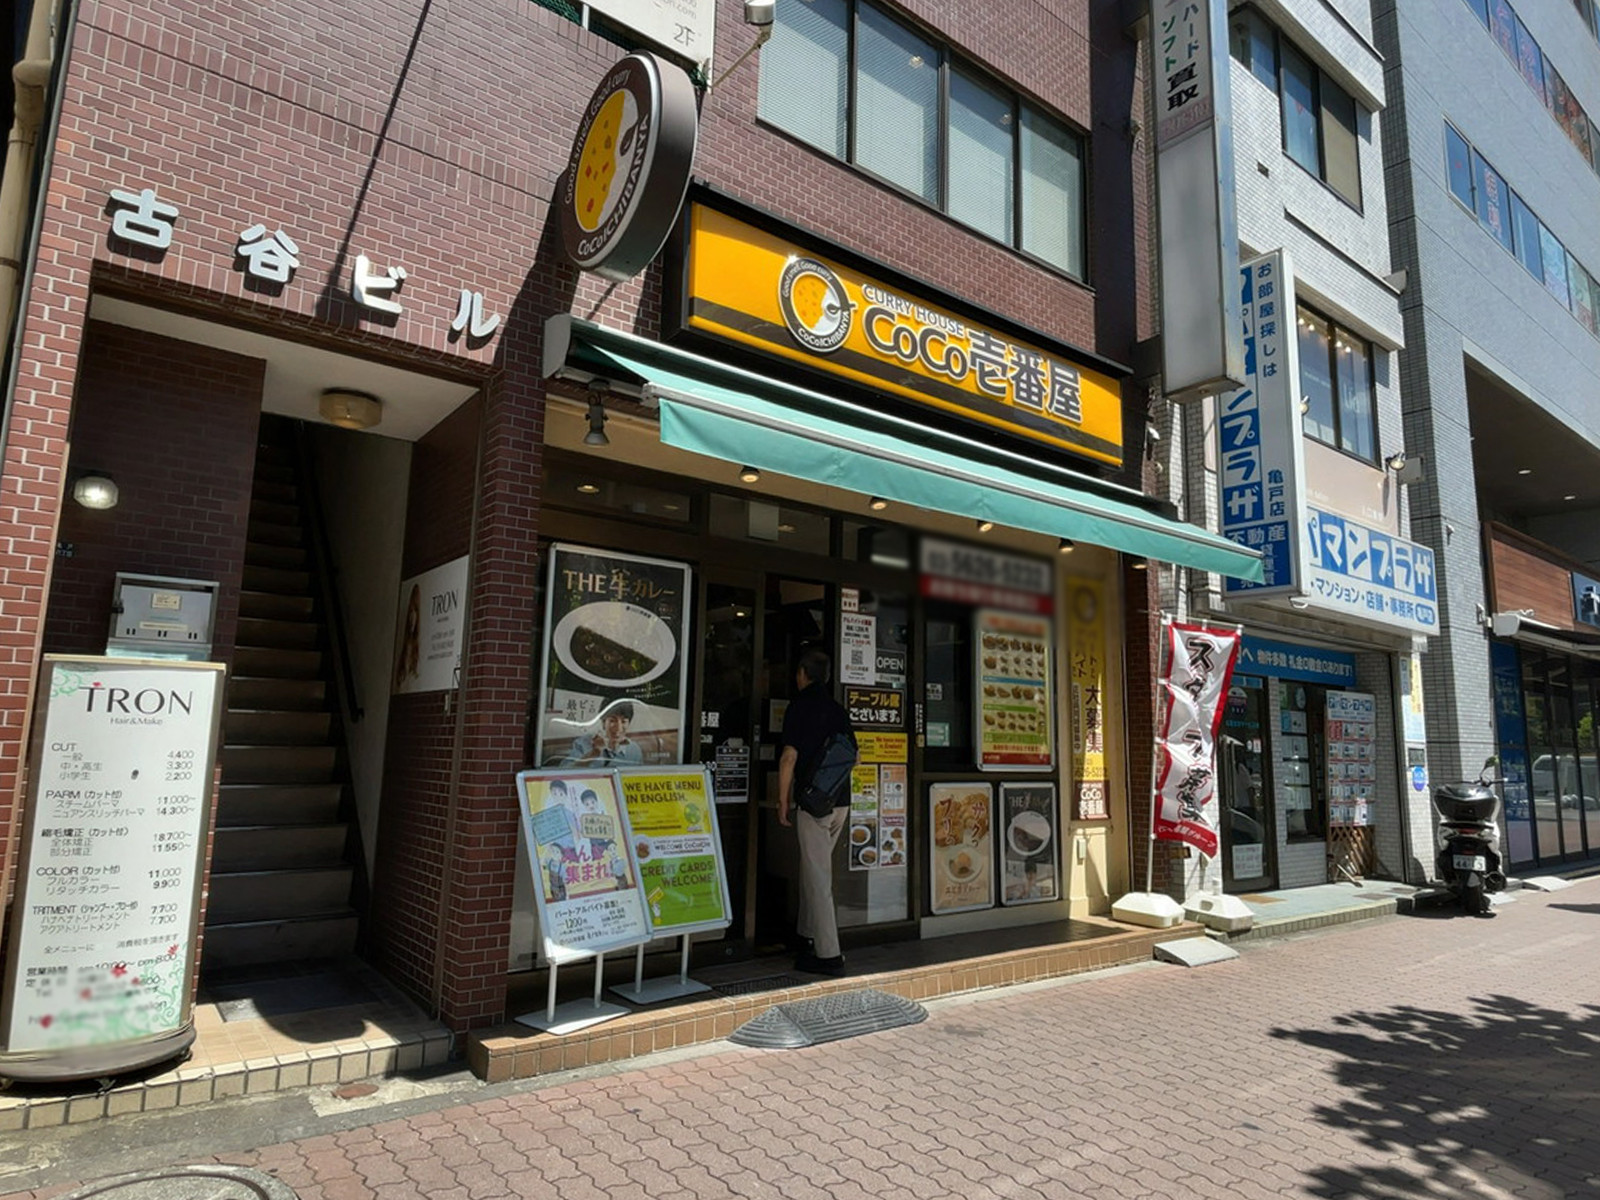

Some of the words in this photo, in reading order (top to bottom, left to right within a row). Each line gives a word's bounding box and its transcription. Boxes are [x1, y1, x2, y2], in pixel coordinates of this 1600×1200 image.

[673, 22, 696, 47] 2F
[1161, 15, 1177, 72] ソフト
[1183, 4, 1199, 59] ハード
[1167, 62, 1199, 111] 買取
[110, 188, 501, 338] 古谷ビル
[862, 283, 914, 315] CURRY
[914, 302, 965, 337] HOUSE
[1257, 262, 1278, 378] お部屋探しは
[1267, 469, 1285, 517] 亀戸店
[1227, 526, 1287, 545] 不動産
[431, 588, 458, 616] TRON
[876, 656, 904, 671] OPEN
[78, 684, 194, 716] TRON
[1085, 685, 1102, 753] 大募集
[51, 742, 78, 752] CUT
[59, 771, 92, 781] 小学生
[624, 782, 642, 792] WE
[644, 781, 673, 791] HAVE
[674, 780, 701, 790] MENU
[45, 790, 81, 799] PARM
[626, 794, 638, 804] IN
[36, 866, 79, 876] COLOR
[640, 863, 676, 878] CREDIT
[679, 860, 715, 874] CARDS
